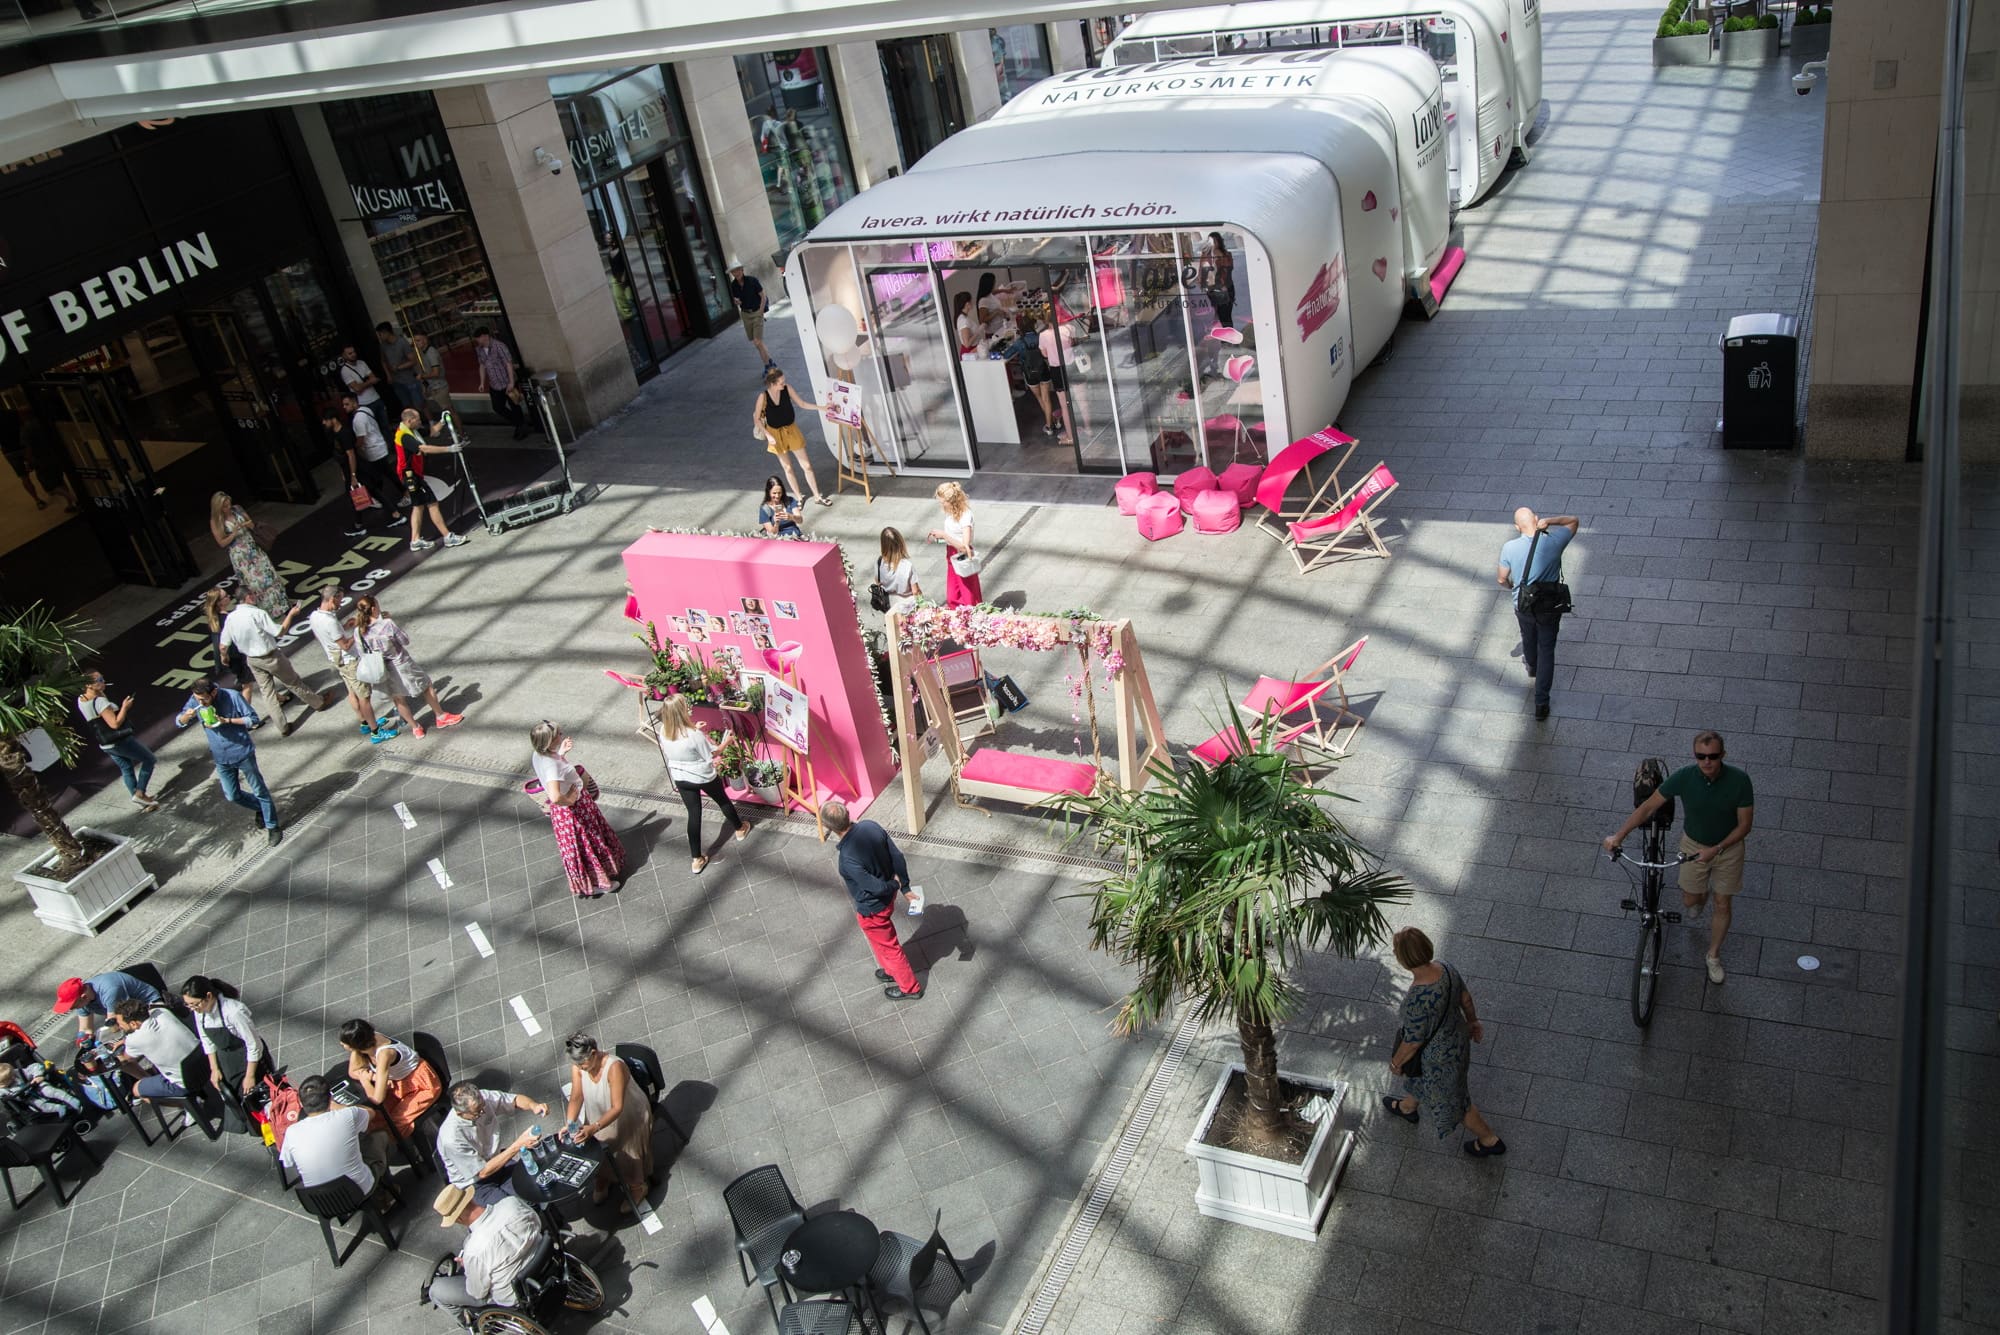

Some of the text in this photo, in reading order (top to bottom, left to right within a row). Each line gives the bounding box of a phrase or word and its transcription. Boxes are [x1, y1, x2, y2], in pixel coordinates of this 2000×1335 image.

[1042, 74, 1317, 105] NATURKOSMETIK
[618, 108, 651, 143] TEA
[1412, 98, 1442, 150] laver
[350, 179, 455, 217] KUSMI TEA
[861, 202, 1178, 230] lavera. wirkt natürlich schön.
[49, 231, 219, 334] BERLIN
[350, 568, 391, 592] 80
